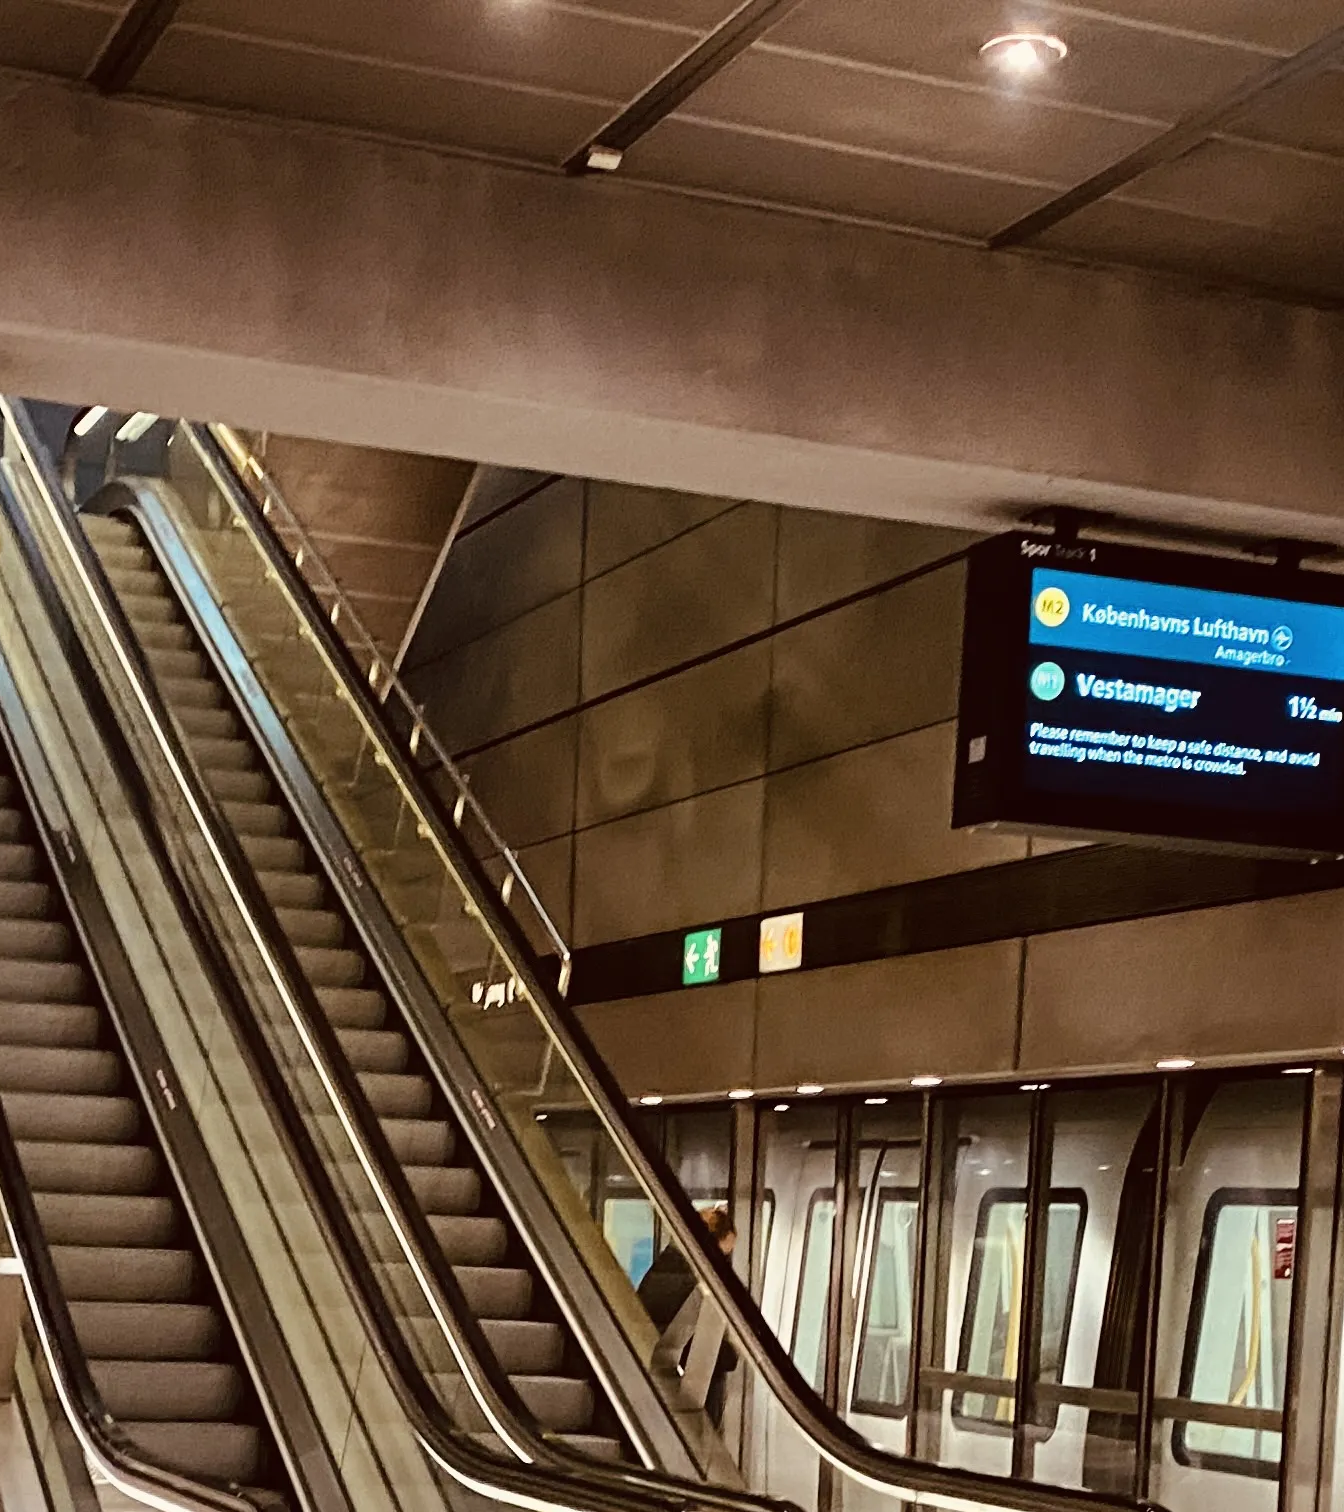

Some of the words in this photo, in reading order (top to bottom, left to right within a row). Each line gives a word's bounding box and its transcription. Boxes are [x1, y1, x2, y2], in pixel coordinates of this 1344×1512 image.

[1089, 548, 1096, 562] 1
[1041, 600, 1064, 615] M2
[1082, 603, 1190, 635] Københavns
[1193, 617, 1270, 645] Lufthavn
[1214, 645, 1285, 667] Amagerbro
[1076, 673, 1201, 713] Vestamager
[1318, 708, 1343, 723] min
[1029, 741, 1087, 762] travelling
[1087, 746, 1121, 762] when
[1122, 750, 1143, 765] the
[1144, 754, 1181, 769] metro
[1181, 755, 1192, 770] is
[1030, 722, 1068, 740] Please
[1069, 730, 1131, 747] remember
[1131, 734, 1146, 749] to
[1146, 734, 1177, 754] keep
[1177, 740, 1186, 752] a
[1187, 739, 1213, 756] safe
[1213, 742, 1263, 762] distance,
[1264, 749, 1288, 764] and
[1288, 752, 1321, 767] avoid
